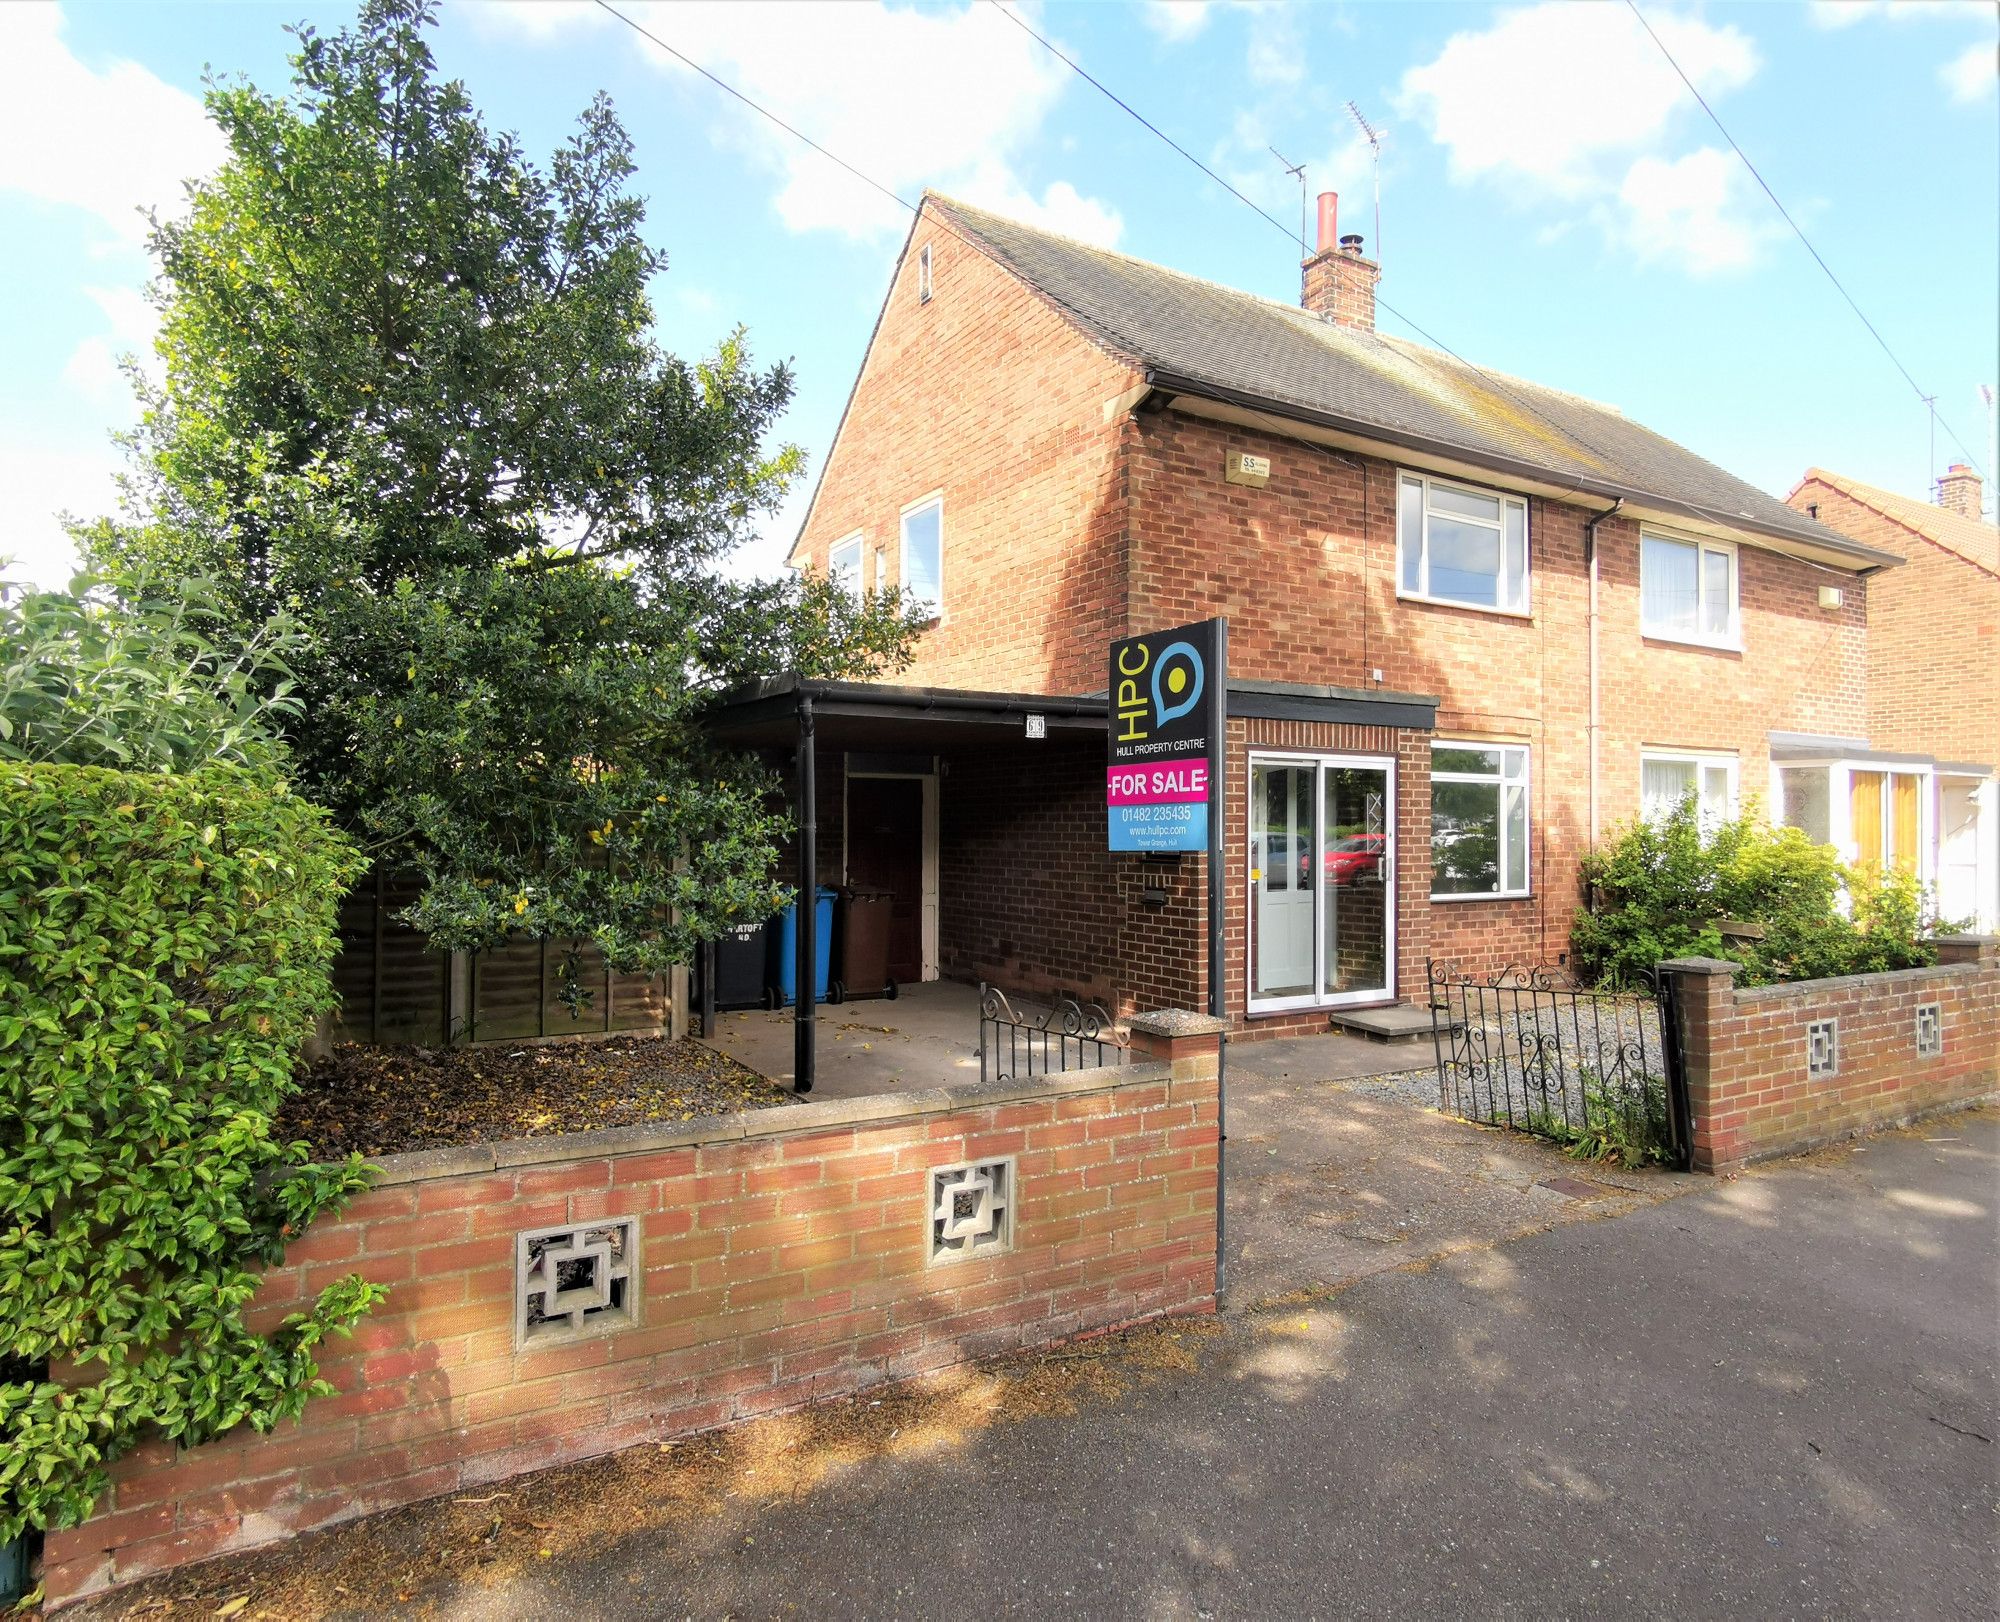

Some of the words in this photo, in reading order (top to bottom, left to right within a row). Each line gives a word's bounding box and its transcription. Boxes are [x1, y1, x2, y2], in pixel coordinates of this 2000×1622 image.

[1117, 642, 1150, 741] HPC
[1116, 746, 1134, 757] HULL
[1135, 742, 1173, 755] PROPERTY
[1173, 738, 1205, 751] CENTRE
[1111, 773, 1147, 796] FOR
[1151, 769, 1204, 794] SALE
[1122, 807, 1151, 822] 01482
[1153, 805, 1191, 821] 235435
[1129, 825, 1186, 837] www.hullpc.com
